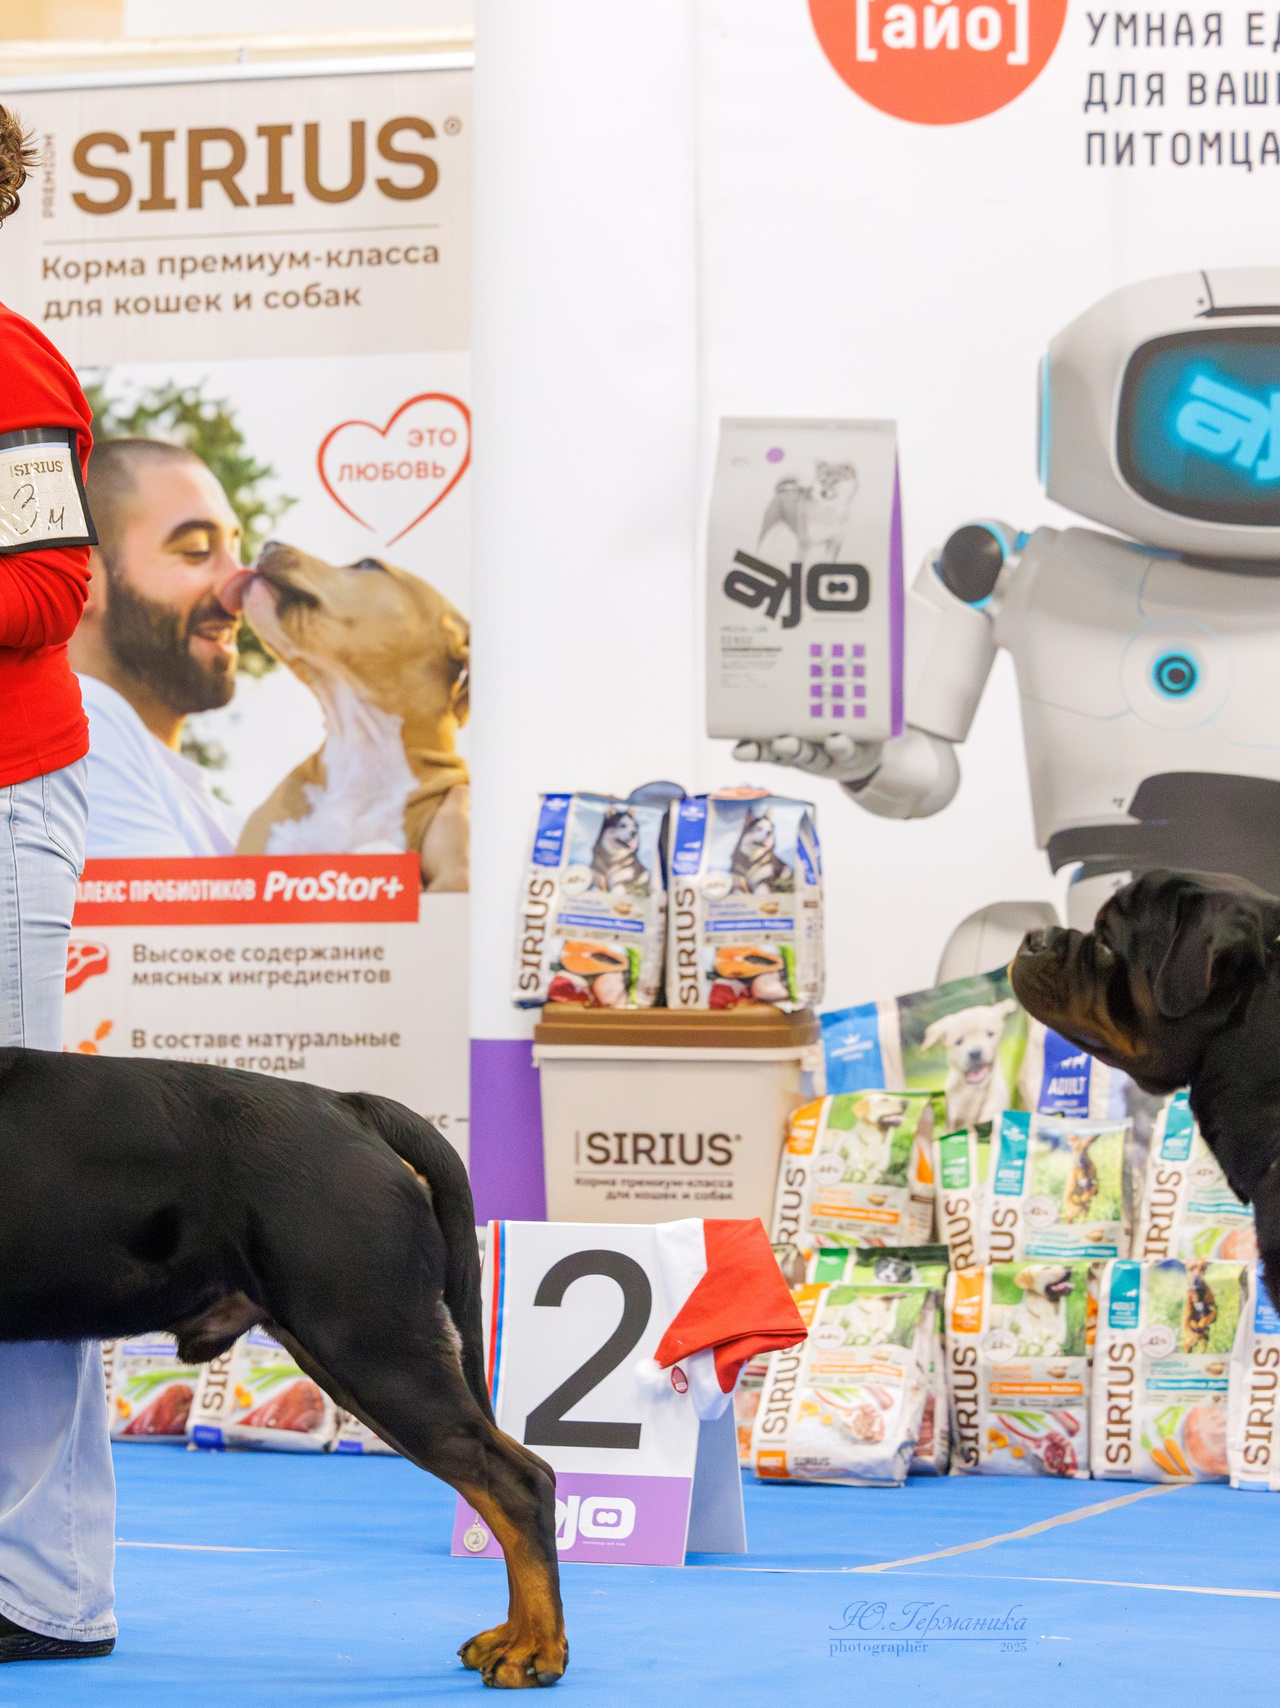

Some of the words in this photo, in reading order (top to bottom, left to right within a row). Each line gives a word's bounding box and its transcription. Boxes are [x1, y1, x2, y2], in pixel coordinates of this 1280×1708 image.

[1087, 12, 1223, 46] УМНАЯ
[1084, 72, 1166, 113] ДЛЯ
[1188, 72, 1280, 107] ВАШ
[1086, 131, 1280, 172] ПИТОМЦА
[42, 256, 146, 284] Корма
[157, 243, 440, 278] премиум-класса
[43, 297, 102, 322] для
[113, 291, 222, 317] кошек
[233, 291, 252, 311] и
[263, 282, 362, 310] собак
[407, 428, 457, 448] ЭТО
[13, 461, 63, 477] SIRIUS
[336, 460, 446, 483] ЛЮБОВЬ
[129, 878, 257, 902] ПРОБИОТИКОВ
[263, 870, 405, 902] ProStor+
[132, 944, 236, 964] Высокое
[240, 944, 386, 965] содержание
[520, 878, 555, 992] SIRIUS
[675, 887, 700, 1006] SIRIUS
[132, 970, 223, 986] мясных
[228, 967, 392, 989] ингредиентов
[131, 1029, 147, 1048] В
[152, 1031, 242, 1049] составе
[247, 1030, 402, 1052] натуральные
[778, 1167, 807, 1245] RIUS
[1143, 1169, 1182, 1260] IRIUS
[944, 1197, 977, 1271] RIUS
[524, 1249, 653, 1450] 2
[1104, 1342, 1136, 1464] SIRIUS
[1243, 1347, 1280, 1465] SIRIUS
